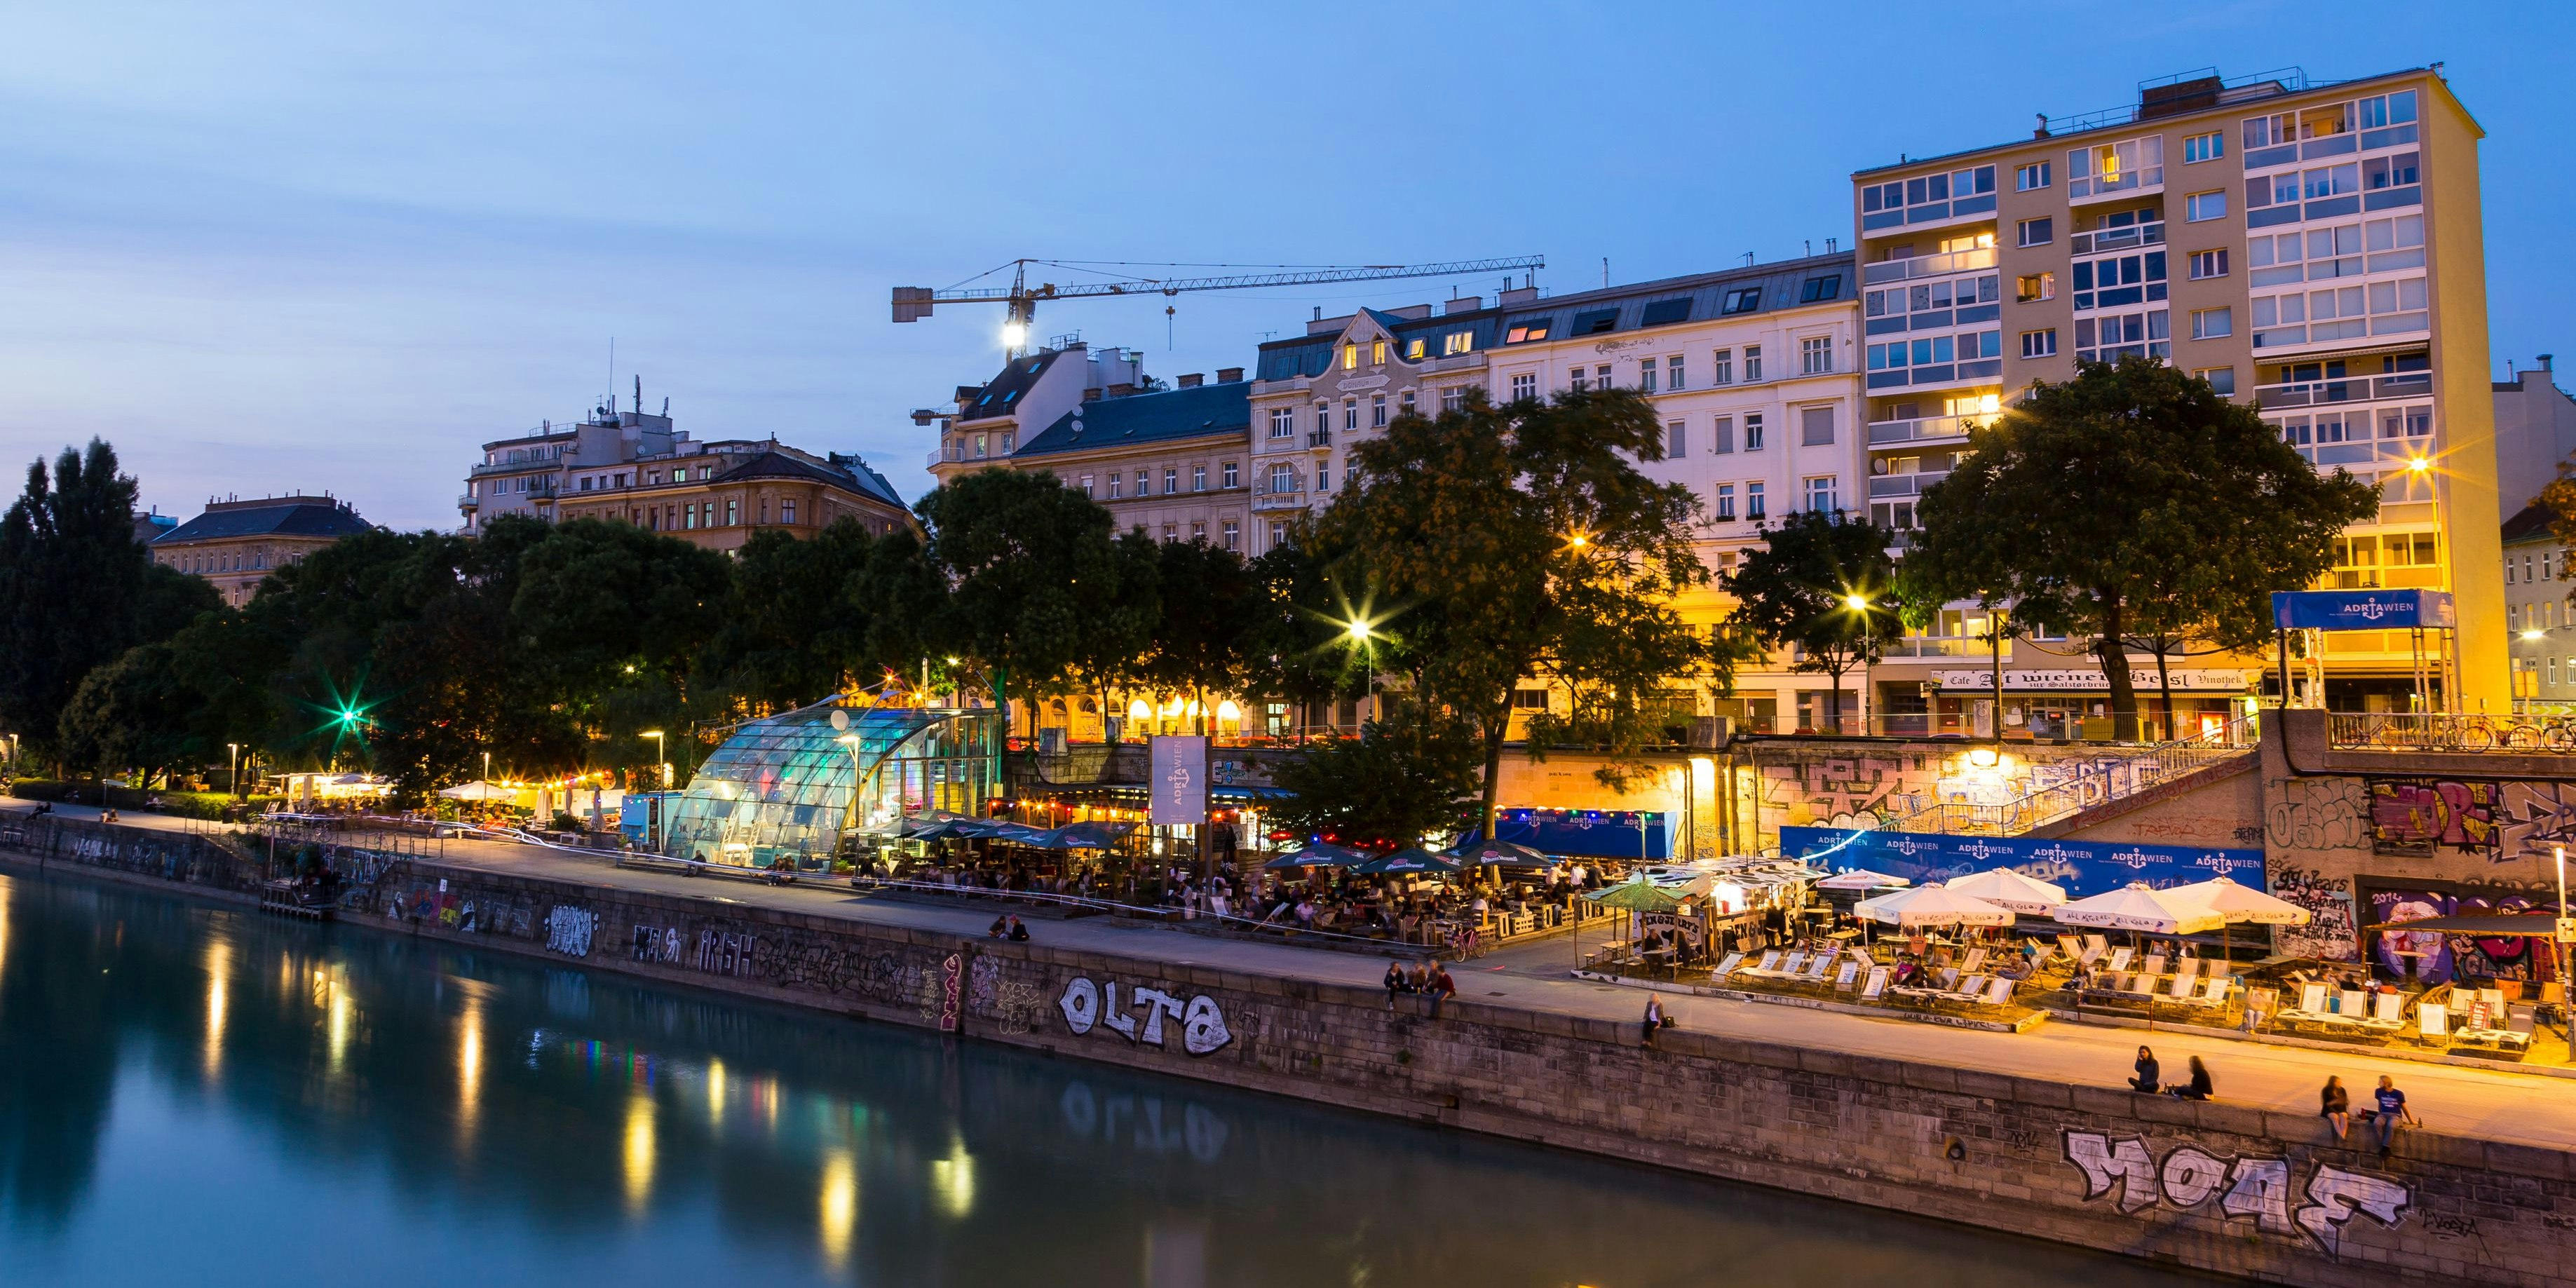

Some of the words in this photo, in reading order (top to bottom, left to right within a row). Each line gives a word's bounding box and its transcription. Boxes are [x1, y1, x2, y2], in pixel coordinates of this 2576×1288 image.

[1950, 675, 1970, 685] Cafe
[1979, 673, 2012, 687] At
[2129, 670, 2189, 686] Besl
[2197, 674, 2242, 684] Vinothek
[2372, 892, 2402, 904] 2014
